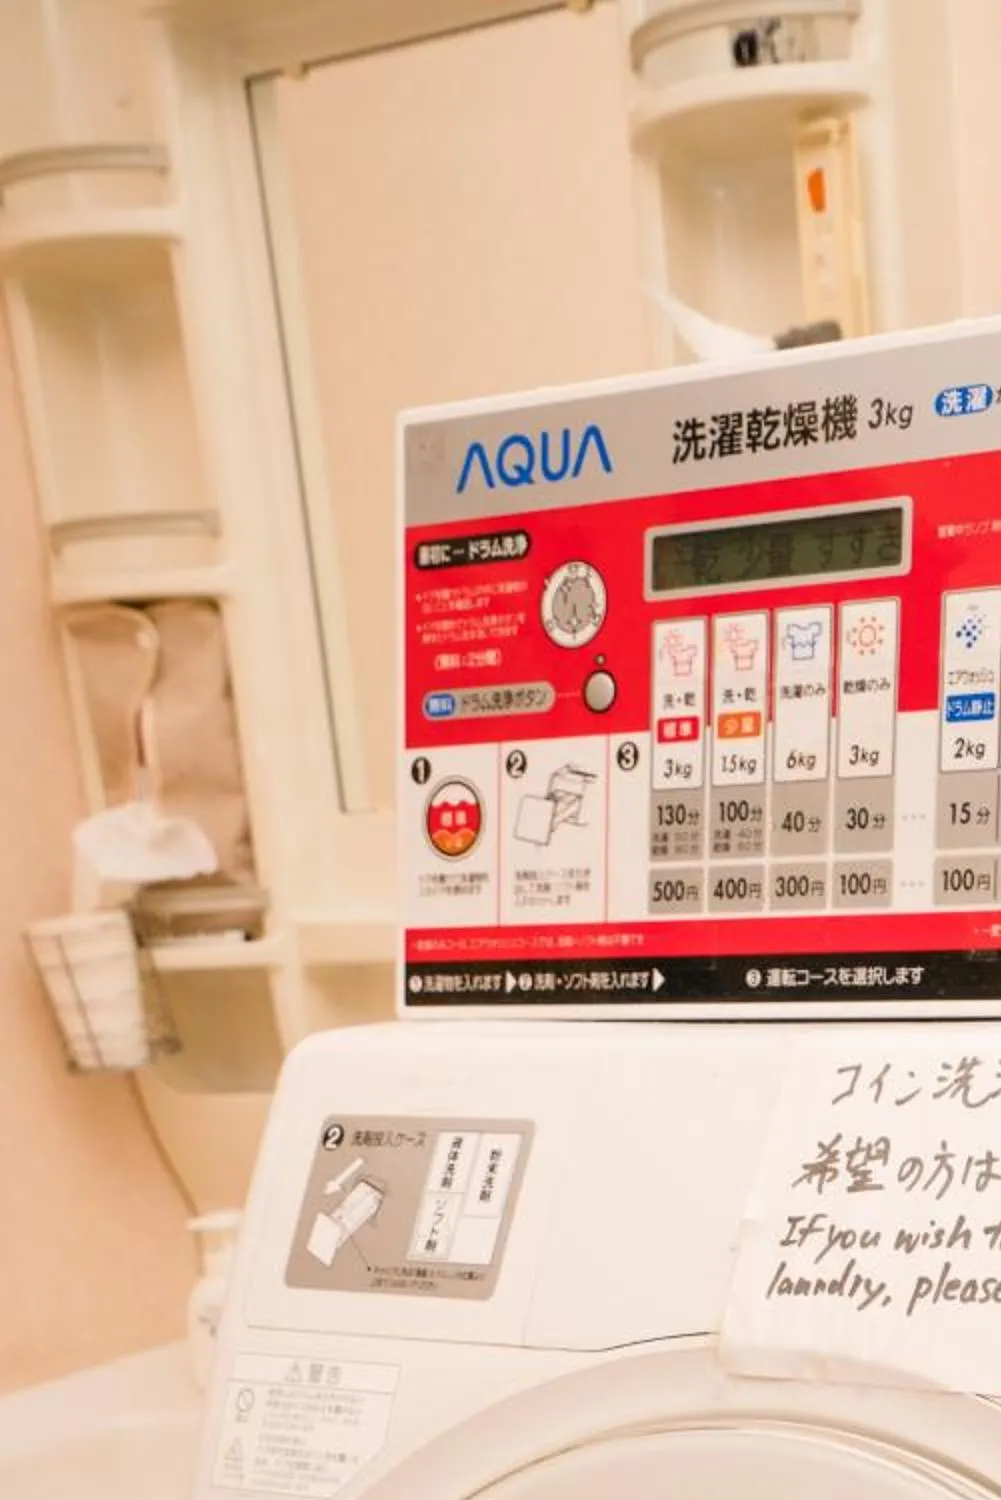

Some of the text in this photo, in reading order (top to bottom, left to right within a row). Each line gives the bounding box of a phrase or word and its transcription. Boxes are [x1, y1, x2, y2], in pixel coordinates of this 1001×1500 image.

[672, 394, 913, 464] 洗濯乾燥機 3kg
[456, 424, 613, 493] AQUA
[786, 748, 817, 772] 6kg
[848, 744, 880, 767] 3kg
[953, 737, 986, 760] 2kg
[662, 758, 694, 780] 3kg
[948, 801, 991, 825] 15分
[652, 879, 699, 902] 500円
[713, 877, 763, 900] 400円
[775, 875, 825, 898] 300円
[839, 873, 888, 896] 100円
[942, 868, 991, 892] 100円
[893, 1214, 972, 1252] wish
